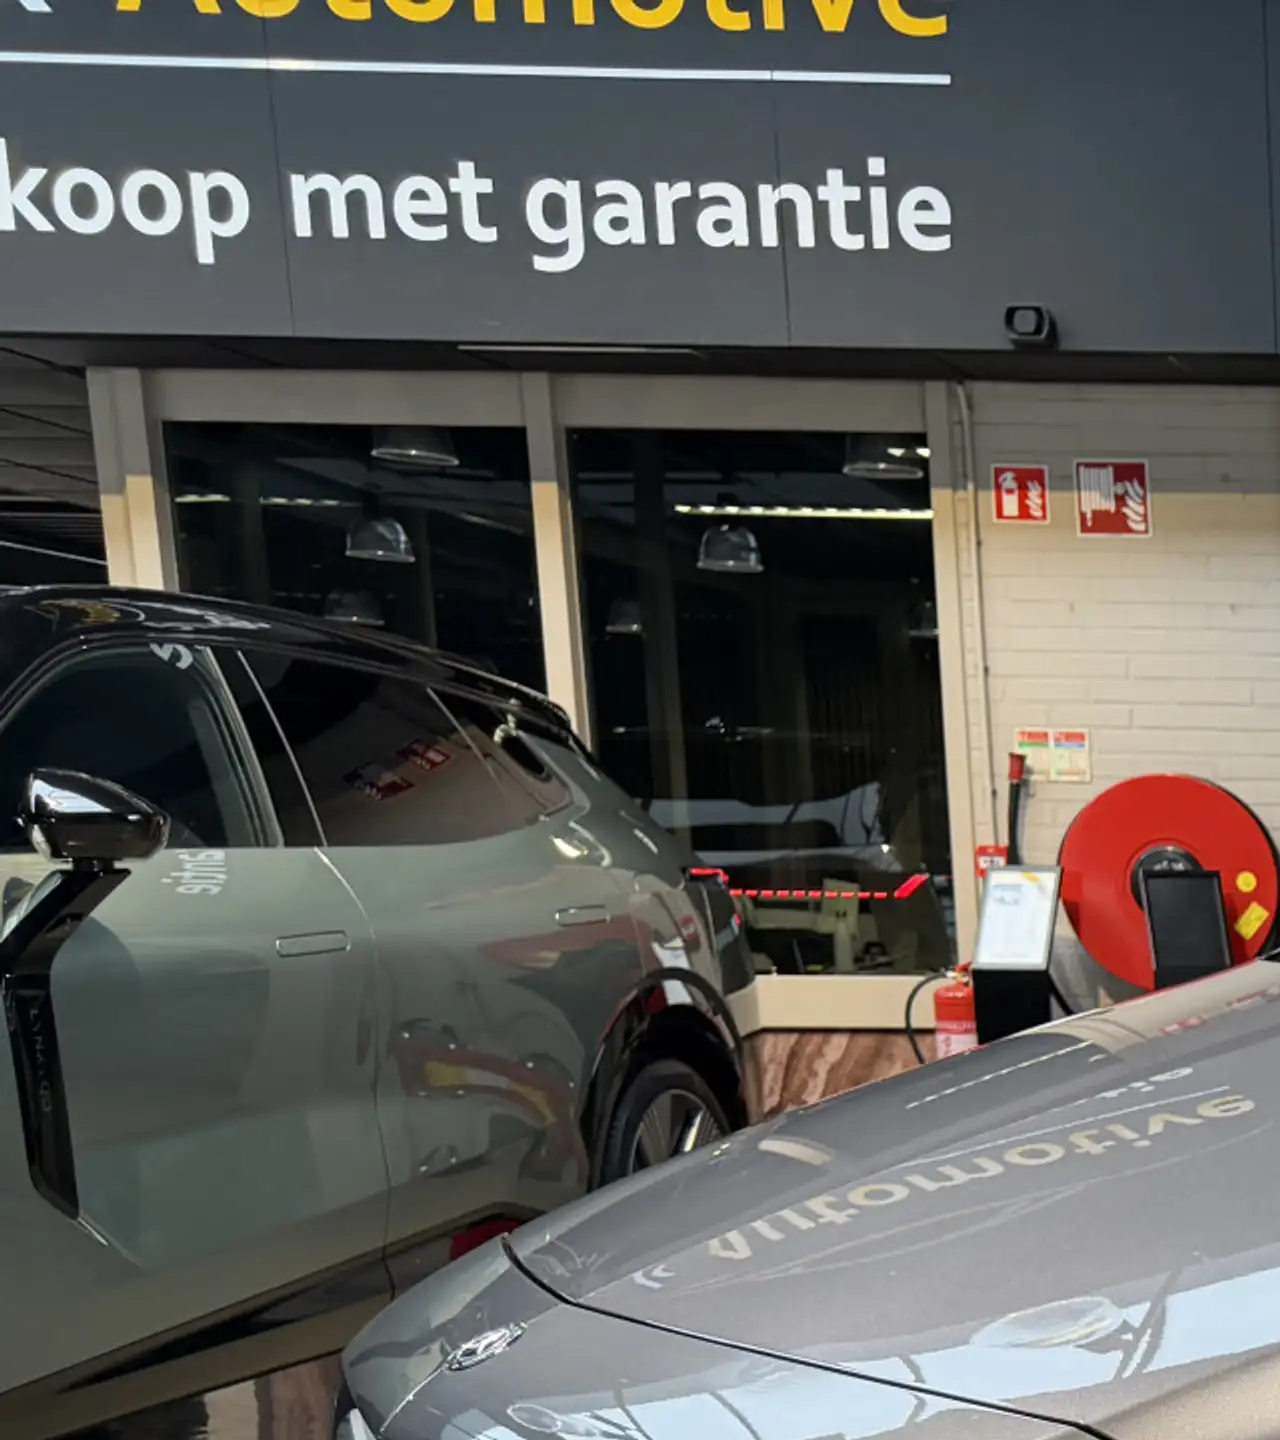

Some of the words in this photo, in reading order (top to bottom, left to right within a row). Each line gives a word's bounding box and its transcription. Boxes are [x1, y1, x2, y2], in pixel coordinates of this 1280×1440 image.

[0, 138, 251, 264] koop
[290, 160, 498, 242] met
[525, 157, 952, 273] garantie
